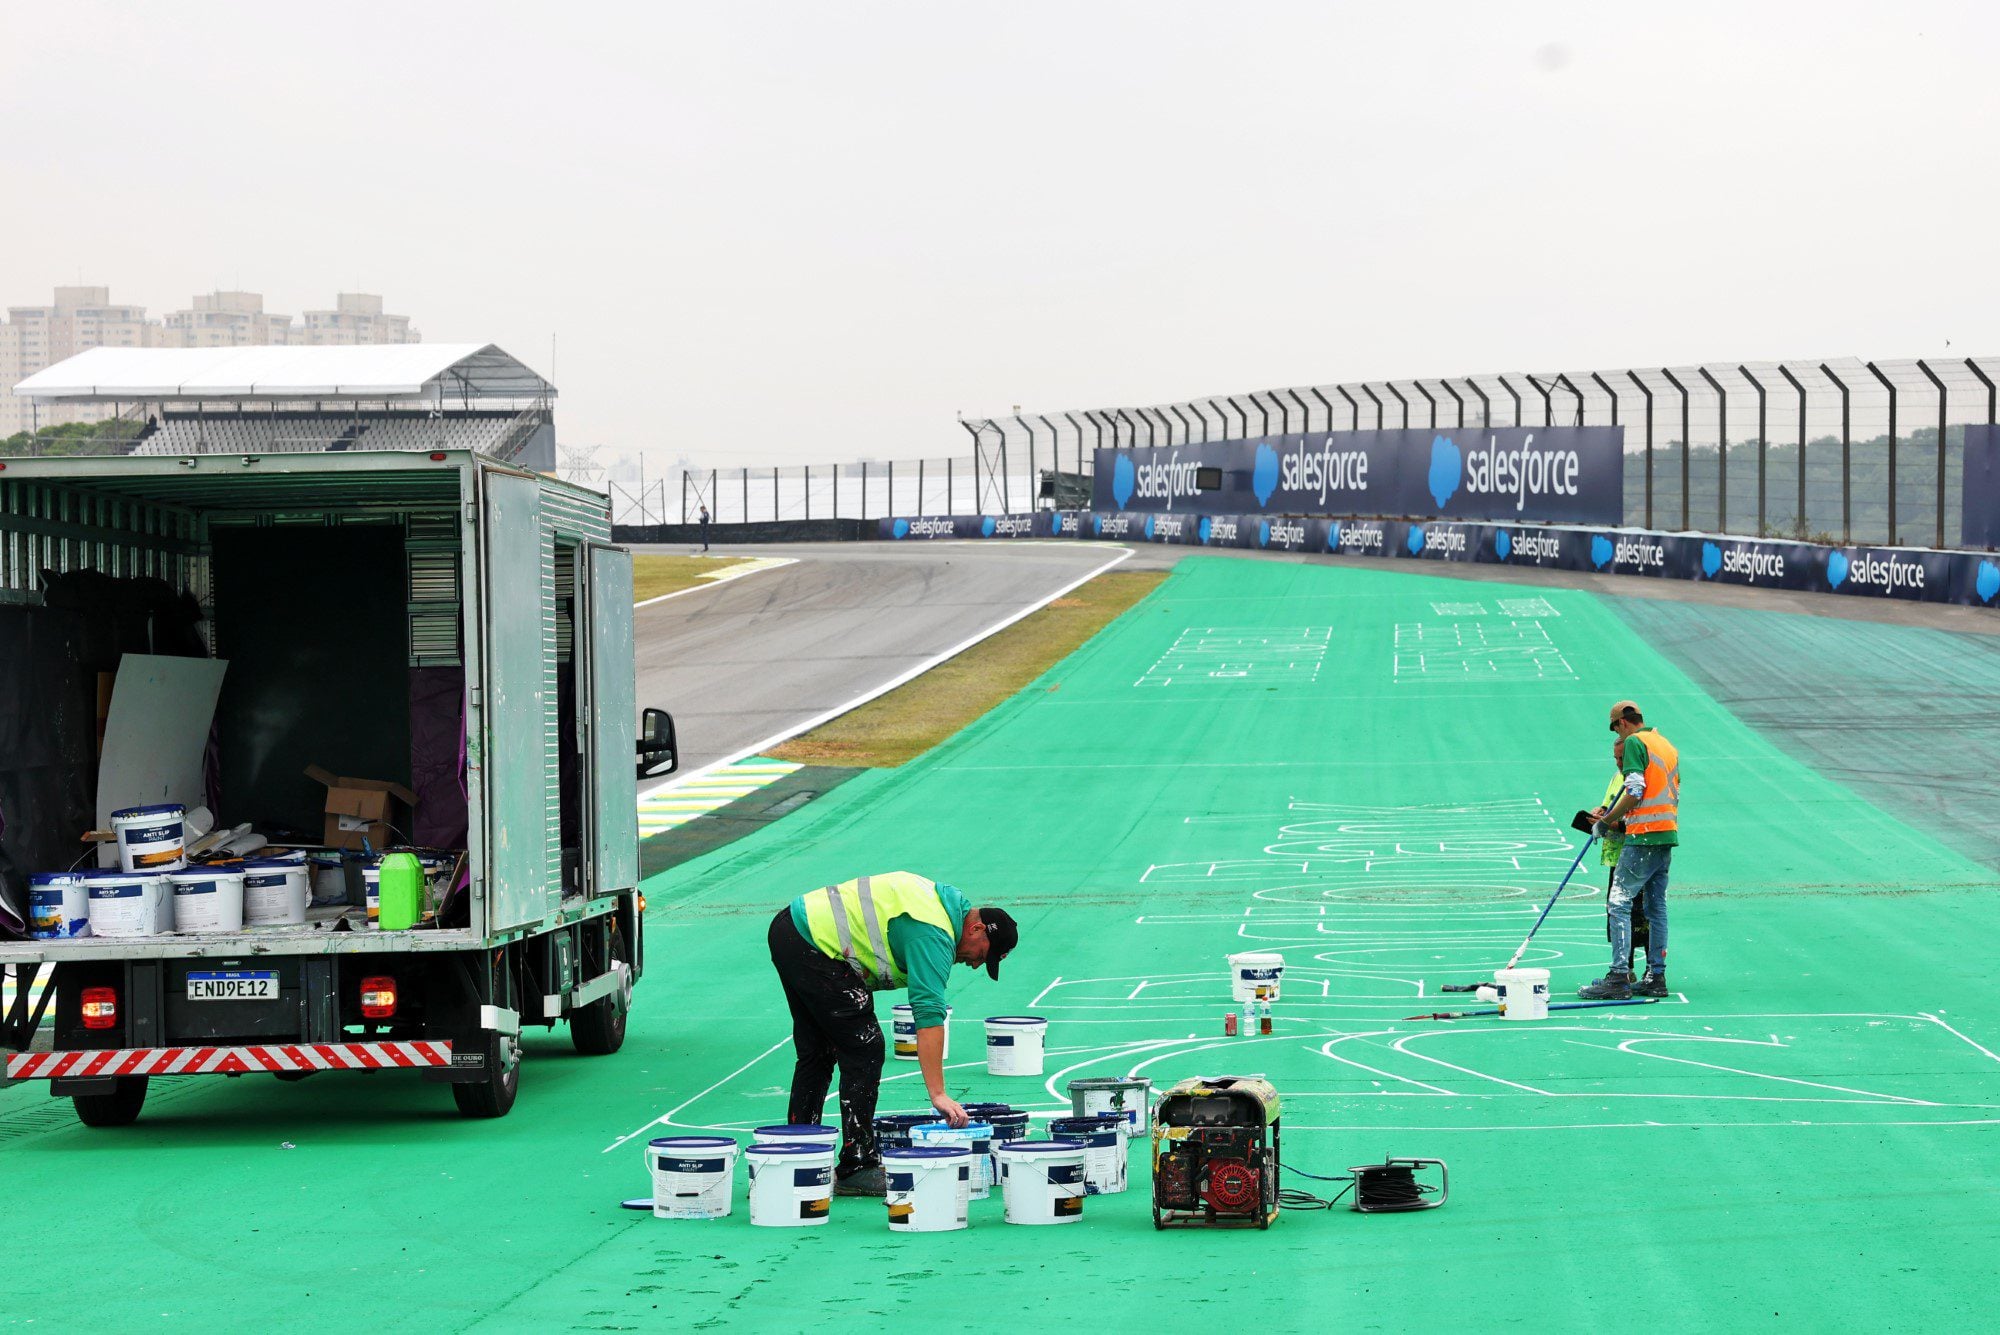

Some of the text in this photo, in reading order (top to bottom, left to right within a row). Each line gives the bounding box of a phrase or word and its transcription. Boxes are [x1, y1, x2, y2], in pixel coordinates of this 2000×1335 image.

[1282, 433, 1368, 506] salesforce
[1467, 434, 1579, 511] salesforce
[910, 516, 954, 539] salesforce
[996, 514, 1032, 538] salesforce
[1270, 518, 1304, 548] salesforce
[1340, 522, 1383, 553] salesforce
[1425, 526, 1465, 557] salesforce
[1512, 530, 1559, 563] salesforce
[1615, 537, 1664, 572] salesforce
[1724, 544, 1784, 582] salesforce
[1850, 551, 1924, 594] salesforce
[194, 980, 268, 997] END9E12
